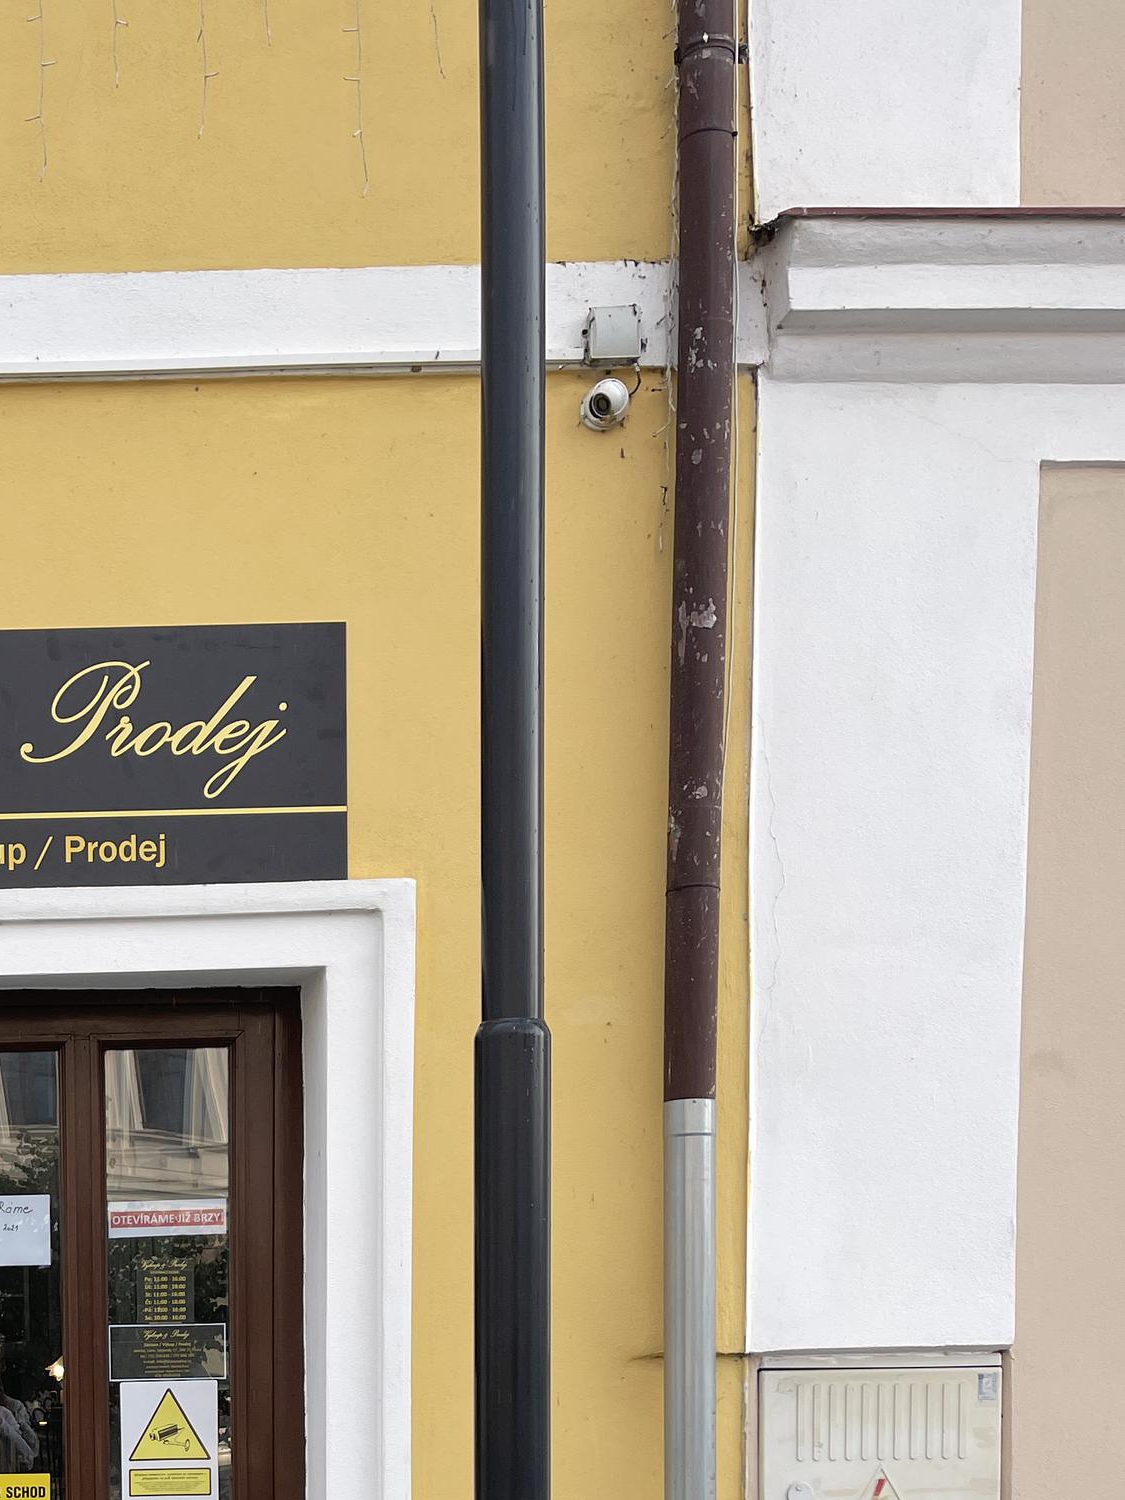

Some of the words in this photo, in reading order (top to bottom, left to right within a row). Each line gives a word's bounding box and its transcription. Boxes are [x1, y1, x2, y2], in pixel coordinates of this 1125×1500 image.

[20, 660, 288, 799] Prodej
[34, 836, 54, 870] /
[64, 833, 167, 868] Prodej
[112, 1211, 175, 1225] OTEVÍRÁME
[6, 1486, 46, 1498] SCHOD
